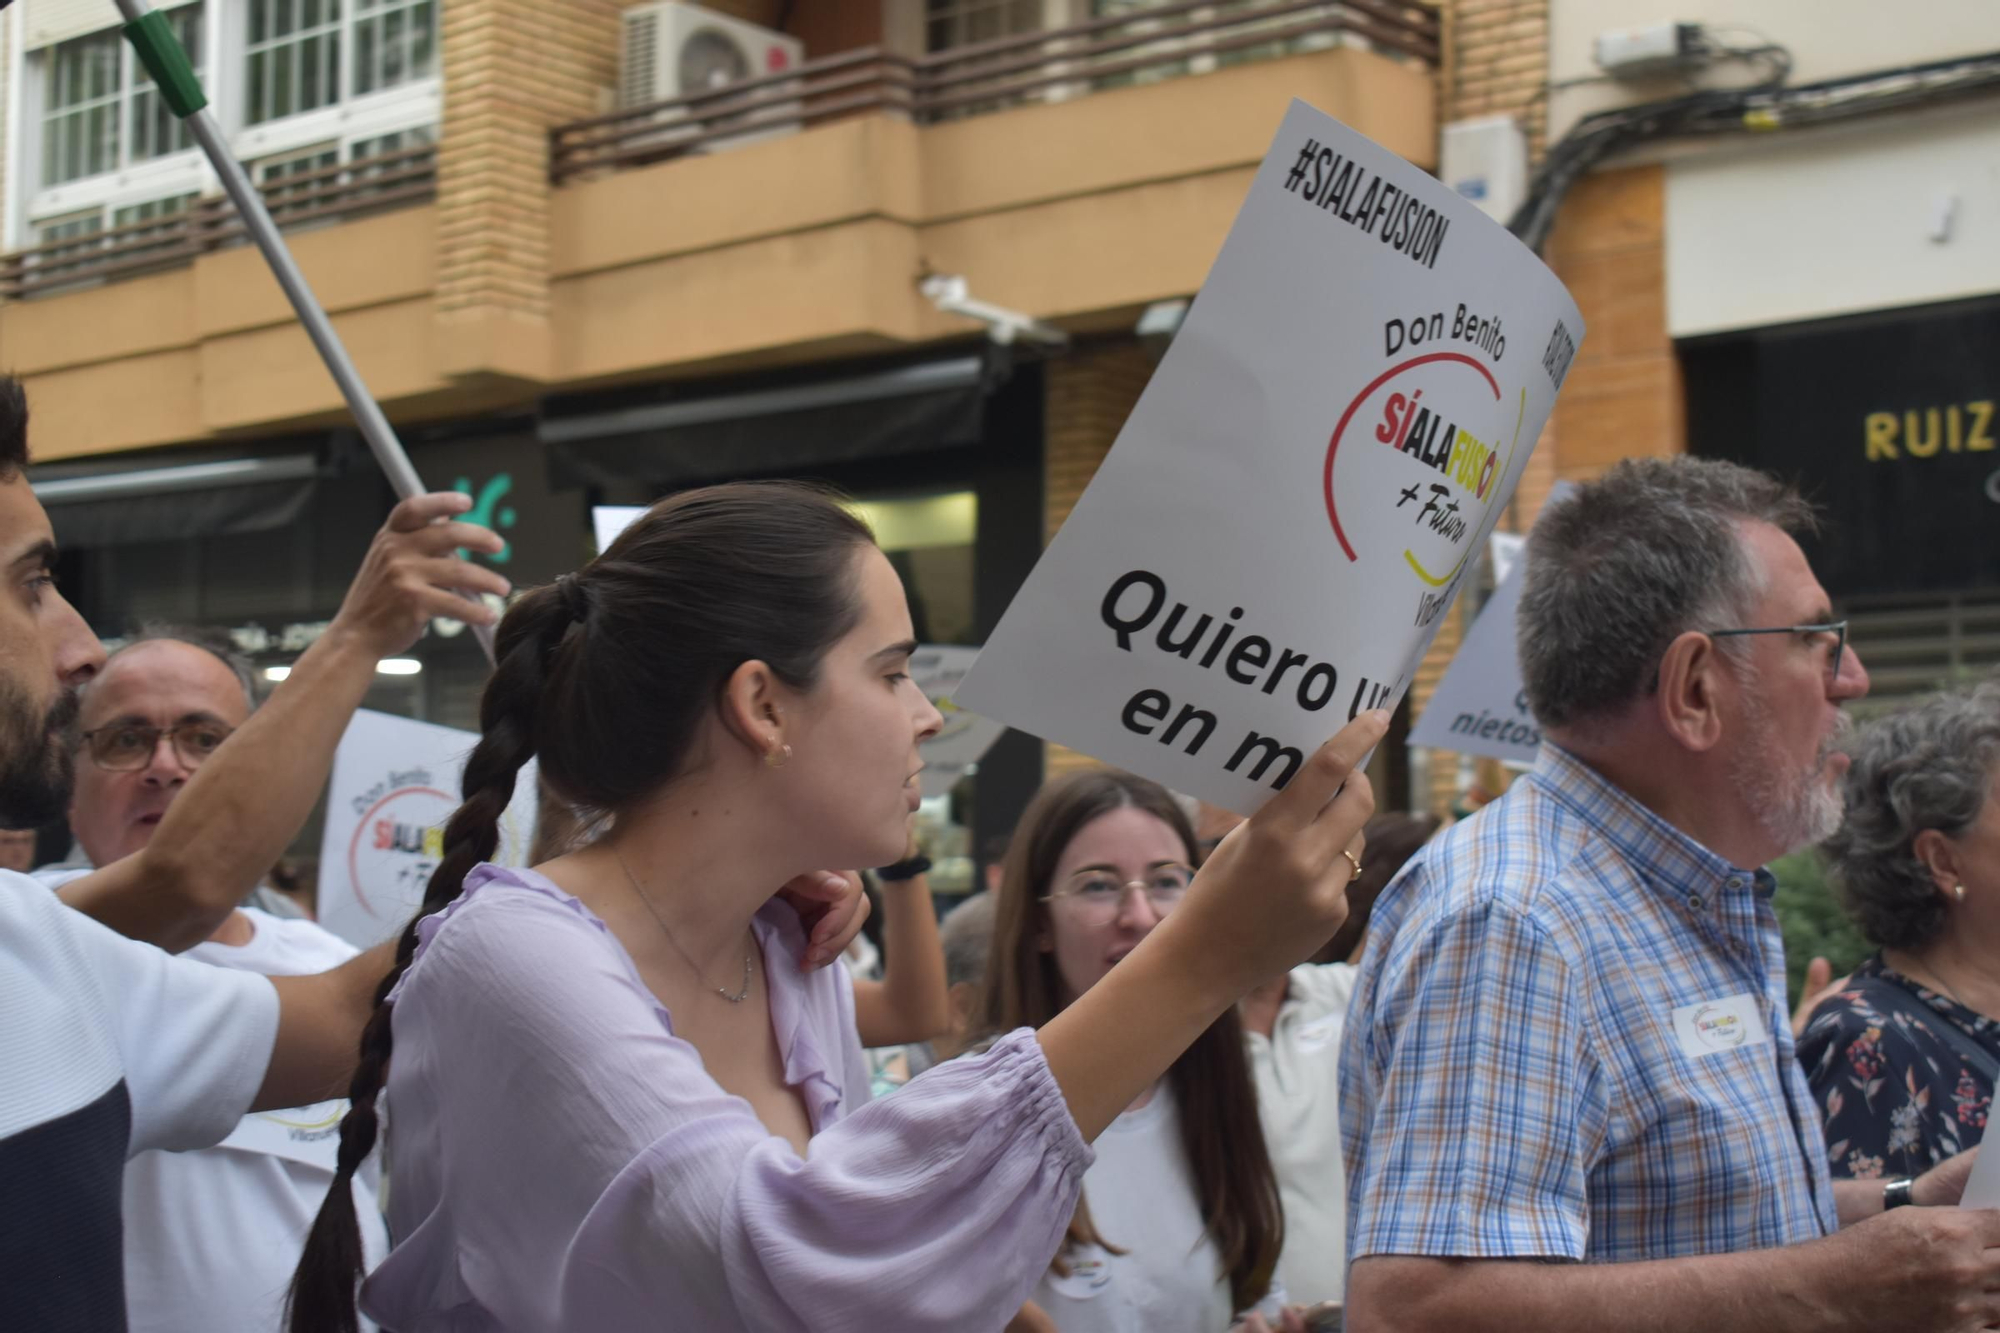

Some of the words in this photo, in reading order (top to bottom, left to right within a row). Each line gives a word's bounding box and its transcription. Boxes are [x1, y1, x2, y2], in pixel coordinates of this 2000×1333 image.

[1284, 138, 1450, 270] #SIALAFUSION
[1385, 312, 1444, 358] Don
[1450, 302, 1506, 362] Benito
[1864, 400, 1996, 462] RUIZ
[1101, 569, 1338, 712] Quiero
[1121, 688, 1218, 756] en
[1222, 730, 1328, 792] m
[1449, 708, 1542, 748] nietos
